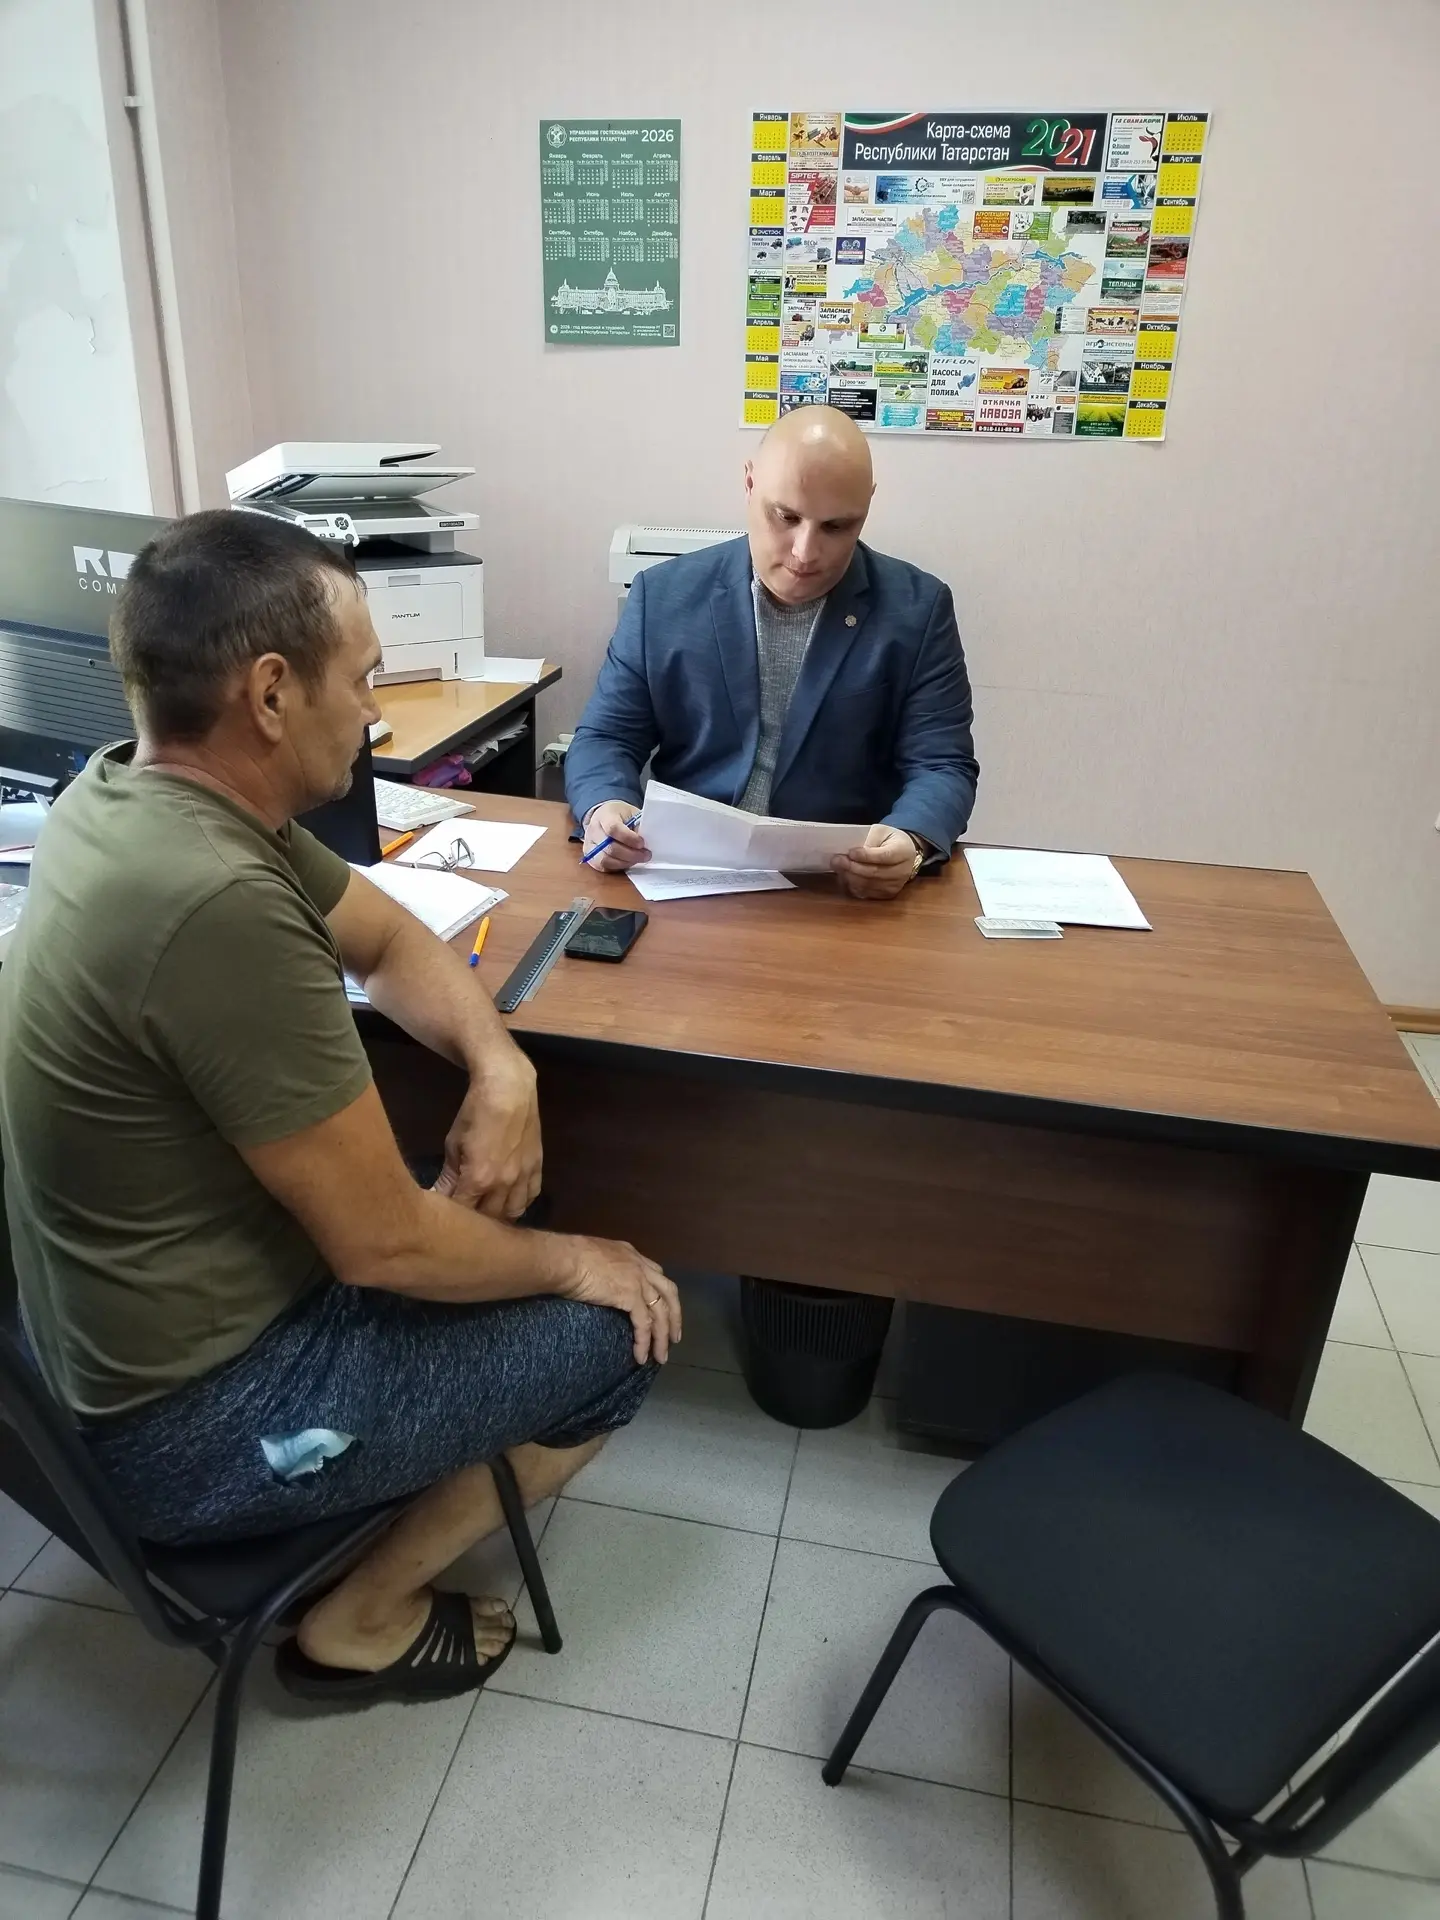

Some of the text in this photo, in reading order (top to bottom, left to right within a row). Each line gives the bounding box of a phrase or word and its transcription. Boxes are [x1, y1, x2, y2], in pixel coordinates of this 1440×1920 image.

[759, 113, 782, 121] Январь
[1177, 114, 1198, 122] Июль
[641, 129, 675, 142] 2026
[926, 121, 1011, 142] Карта-схема
[1021, 118, 1097, 166] 2021
[855, 142, 1010, 164] Республики Татарстан
[757, 154, 781, 162] Февраль
[1169, 155, 1194, 164] Август
[790, 172, 817, 180] SIPTEC
[758, 189, 777, 198] Март
[1163, 198, 1189, 206] Сентябрь
[1140, 362, 1165, 370] Ноябрь
[930, 379, 946, 387] ДЛЯ
[930, 389, 960, 397] ПОЛИВА
[1135, 401, 1159, 409] Декабрь
[979, 408, 1022, 420] НАВОЗА
